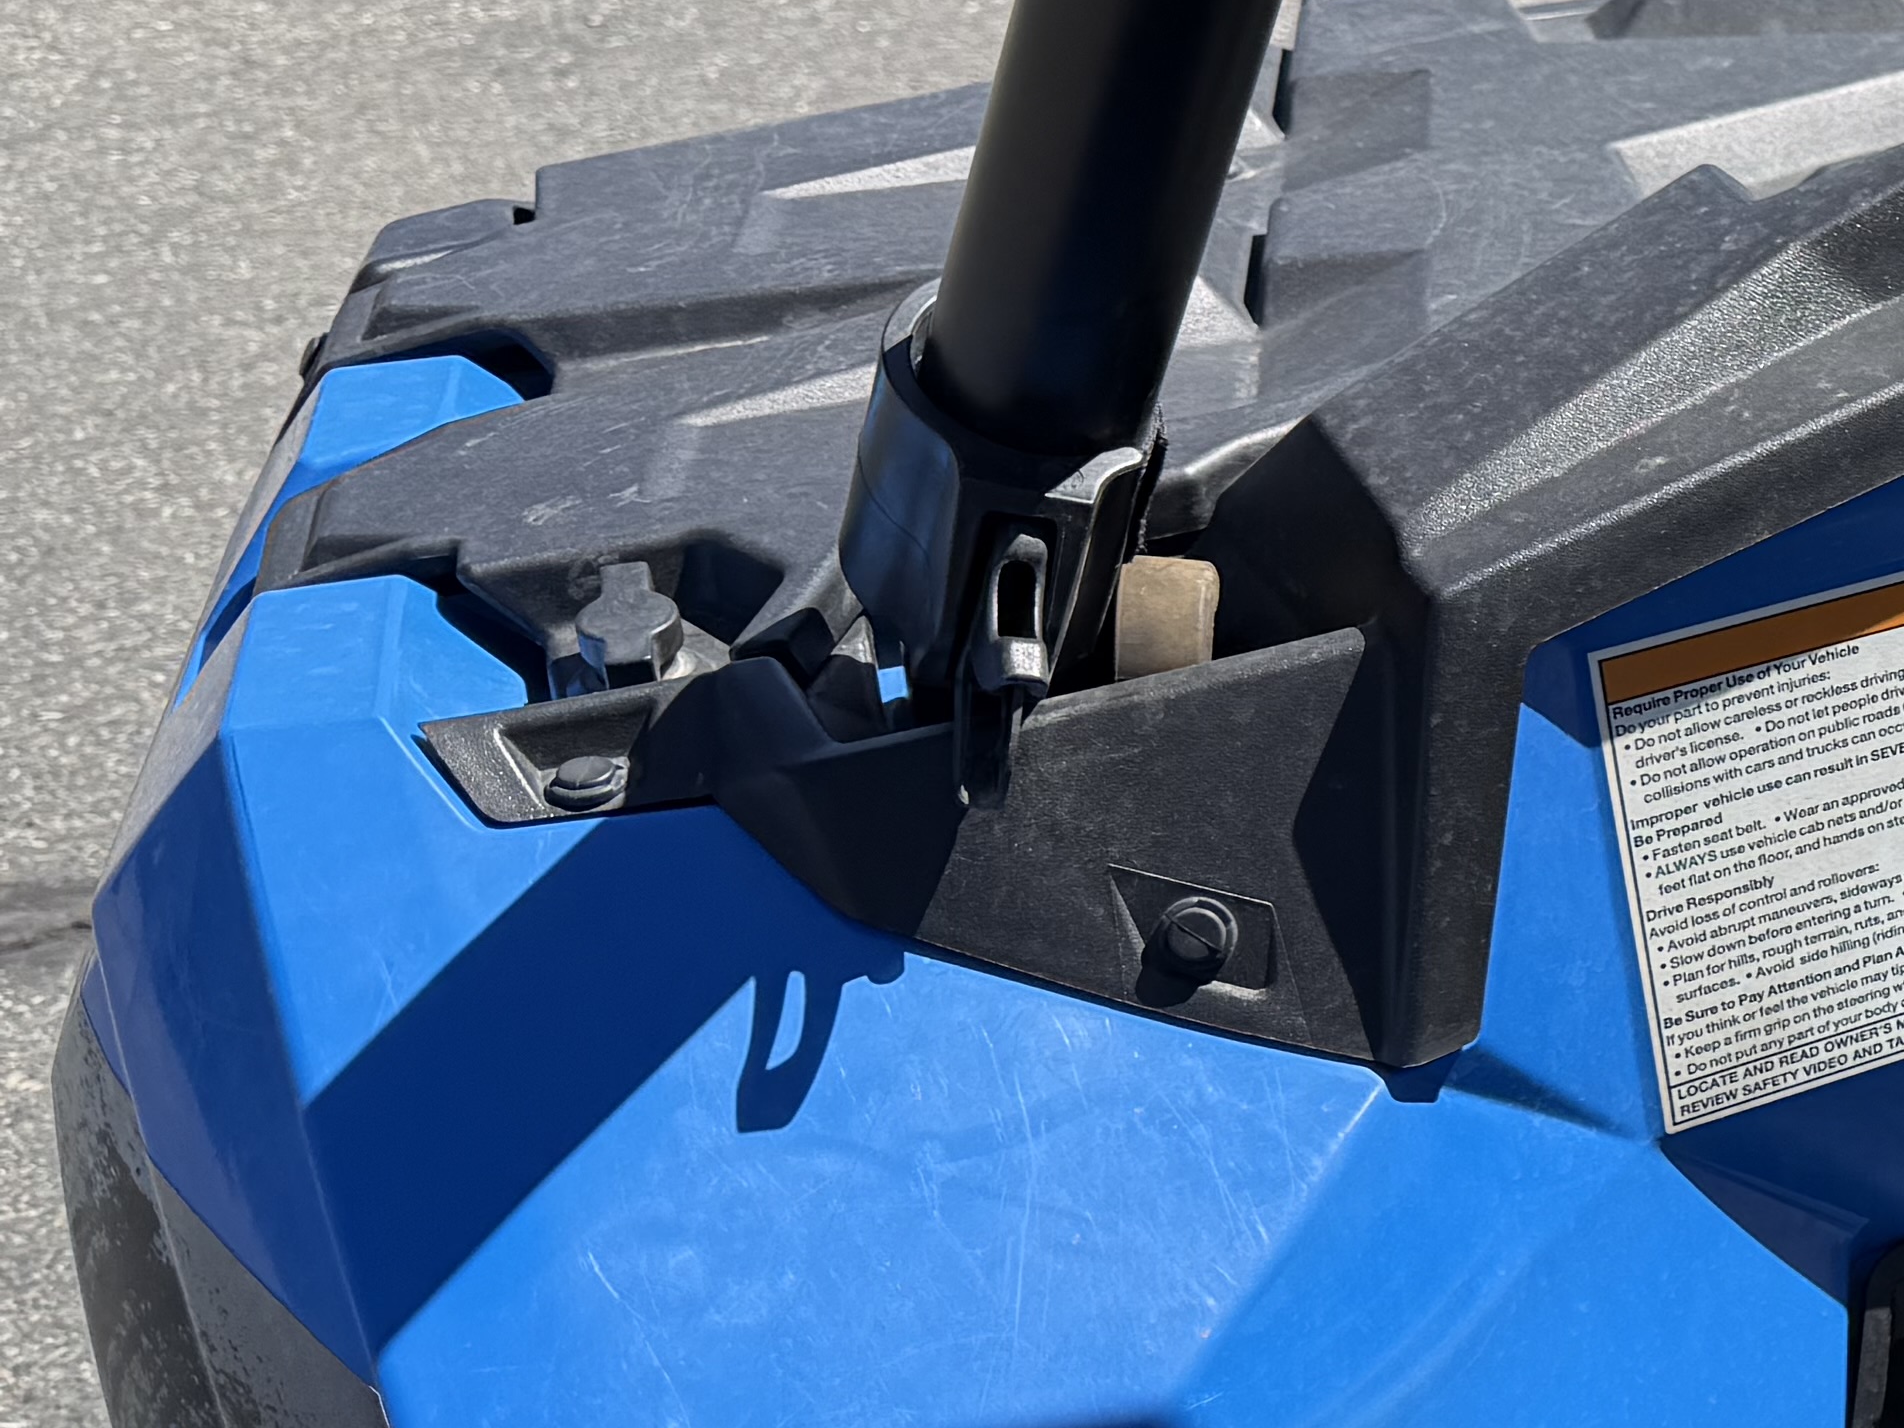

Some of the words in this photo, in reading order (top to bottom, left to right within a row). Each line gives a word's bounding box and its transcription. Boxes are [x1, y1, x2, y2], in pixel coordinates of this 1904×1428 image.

[1611, 692, 1671, 722] Require
[1672, 678, 1725, 705] Proper
[1724, 669, 1756, 689] Use
[1755, 664, 1773, 680] of
[1772, 655, 1807, 676] Your
[1807, 641, 1860, 666] Vehicle
[1614, 720, 1637, 737] Do
[1637, 712, 1672, 734] your
[1672, 702, 1703, 724] part
[1704, 698, 1720, 713] to
[1720, 683, 1776, 711] prevent
[1775, 667, 1832, 696] injuries:
[1633, 737, 1655, 750] Do
[1657, 728, 1681, 744] not
[1683, 718, 1721, 736] allow
[1723, 702, 1782, 725] careless
[1784, 697, 1798, 709] or
[1800, 681, 1858, 704] reckless
[1629, 802, 1698, 830] Improper
[1702, 786, 1754, 809] vehicle
[1756, 779, 1782, 794] use
[1784, 771, 1811, 786] can
[1812, 757, 1853, 778] result
[1854, 754, 1868, 766] in
[1651, 839, 1701, 861] Fasten
[1702, 827, 1733, 846] seat
[1734, 819, 1766, 836] belt.
[1782, 804, 1819, 822] Wear
[1821, 799, 1839, 811] an
[1841, 777, 1904, 806] approved
[1632, 834, 1653, 848] Be
[1655, 811, 1722, 842] Prepared
[1657, 877, 1686, 896] feet
[1687, 870, 1711, 886] flat
[1712, 866, 1731, 879] on
[1732, 859, 1755, 873] the
[1757, 848, 1792, 866] floor,
[1794, 837, 1820, 855] and
[1822, 827, 1865, 847] hands
[1866, 821, 1884, 834] on
[1645, 903, 1683, 922] Drive
[1685, 875, 1774, 910] Responsibly
[1649, 916, 1688, 940] Avoid
[1690, 910, 1720, 927] loss
[1722, 902, 1735, 917] of
[1738, 887, 1787, 912] control
[1789, 879, 1815, 897] and
[1662, 1016, 1682, 1029] Be
[1684, 1005, 1718, 1022] Sure
[1720, 999, 1735, 1011] to
[1737, 990, 1764, 1006] Pay
[1767, 969, 1832, 997] Attention
[1833, 958, 1860, 976] and
[1861, 951, 1893, 968] Plan
[1675, 977, 1740, 1003] surfaces.
[1755, 956, 1794, 979] Avoid
[1799, 949, 1828, 965] side
[1829, 936, 1870, 956] hilling
[1677, 1070, 1739, 1100] LOCATE
[1742, 1059, 1774, 1080] AND
[1777, 1045, 1819, 1068] READ
[1823, 1022, 1892, 1052] OWNER'S
[1686, 1062, 1707, 1075] Do
[1708, 1052, 1732, 1068] not
[1734, 1043, 1757, 1062] put
[1759, 1036, 1784, 1052] any
[1786, 1026, 1814, 1046] part
[1816, 1019, 1830, 1034] of
[1831, 1012, 1862, 1032] your
[1864, 1000, 1898, 1019] body
[1679, 1087, 1738, 1116] REVIEW
[1741, 1067, 1799, 1096] SAFETY
[1801, 1053, 1848, 1076] VIDEO
[1852, 1042, 1883, 1061] AND
